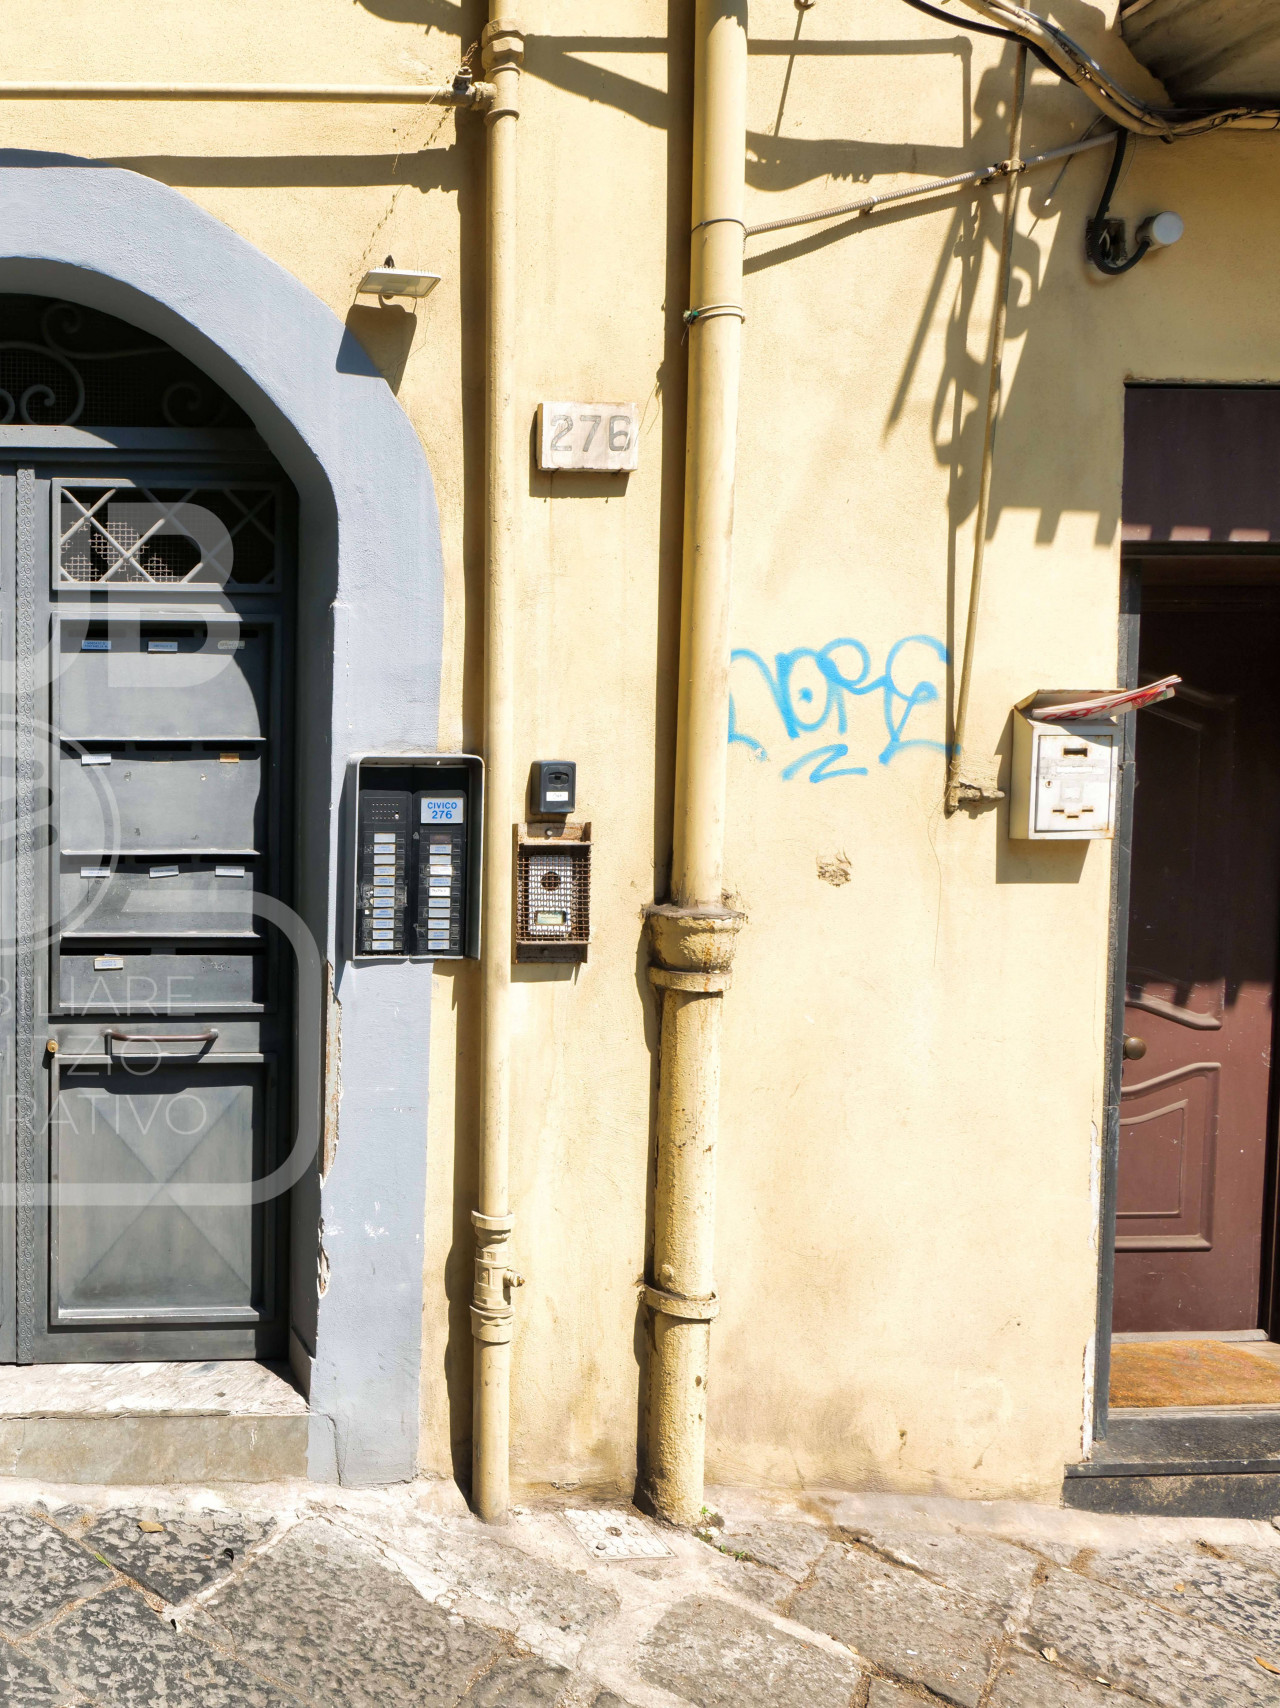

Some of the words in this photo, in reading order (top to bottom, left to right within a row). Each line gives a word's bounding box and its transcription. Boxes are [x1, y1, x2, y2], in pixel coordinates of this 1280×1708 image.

[550, 414, 632, 452] 276
[427, 801, 458, 810] CIVICO
[431, 810, 453, 820] 276
